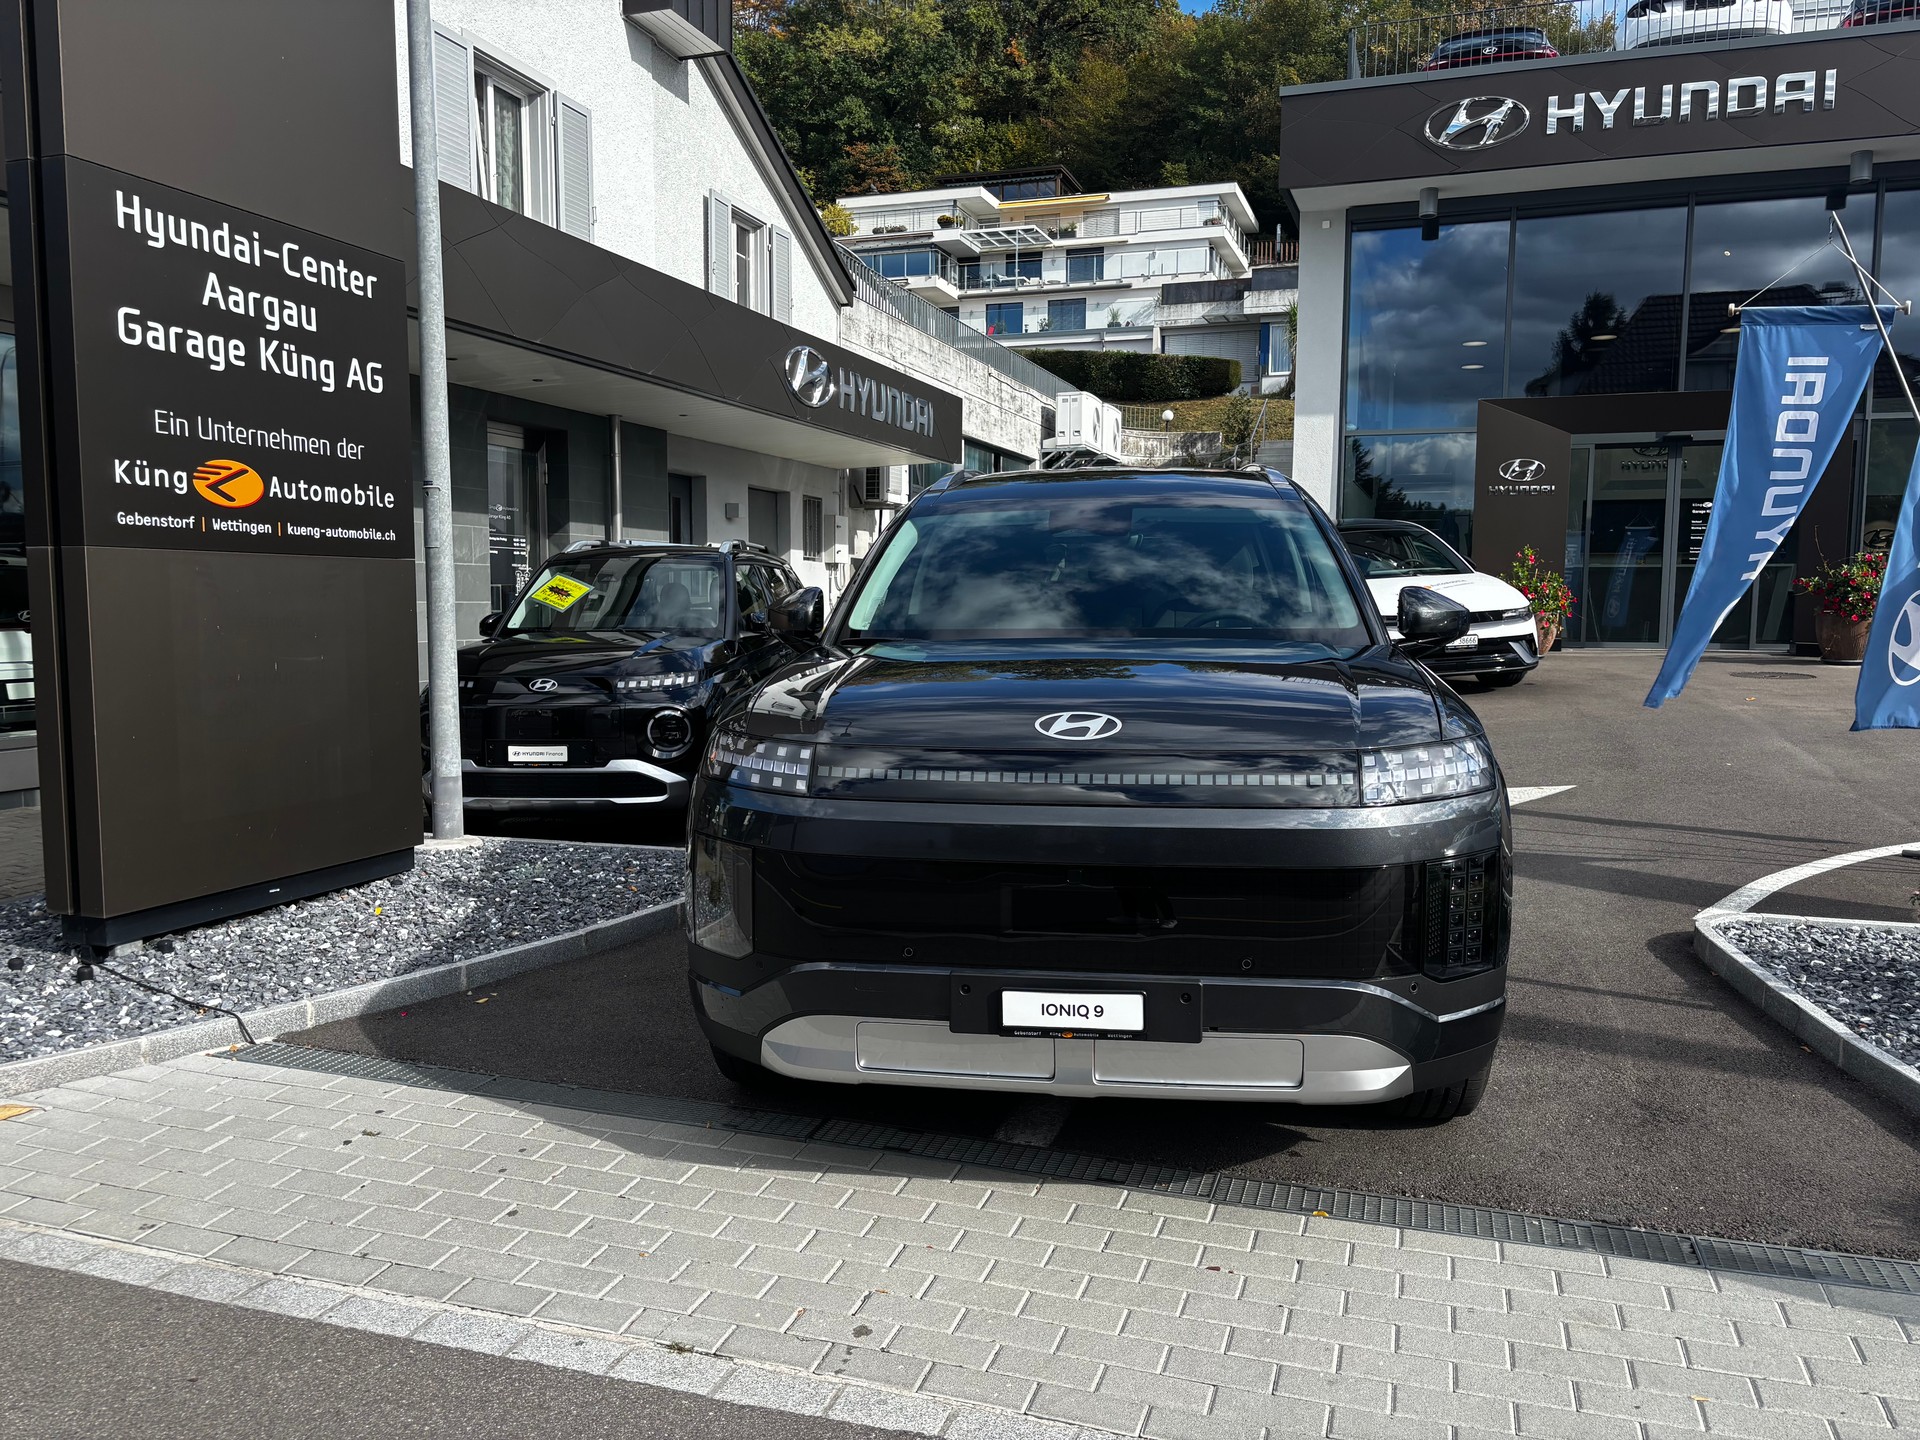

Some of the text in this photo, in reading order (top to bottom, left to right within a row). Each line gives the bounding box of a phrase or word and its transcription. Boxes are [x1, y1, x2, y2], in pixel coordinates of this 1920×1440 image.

[1545, 68, 1838, 135] HYUNDAI
[115, 189, 378, 299] Hyundai-Center
[202, 271, 317, 333] Aargau
[117, 306, 384, 394] Garage Küng AG
[838, 366, 935, 438] HYUNDAI
[154, 409, 365, 460] Ein Unternehmen der
[113, 458, 395, 509] Küng Automobile
[1487, 484, 1556, 497] HYUNDAI
[116, 511, 397, 541] Gebenstorf Wettingen kueng-automobile.ch
[1041, 1003, 1105, 1020] IONIQ 9
